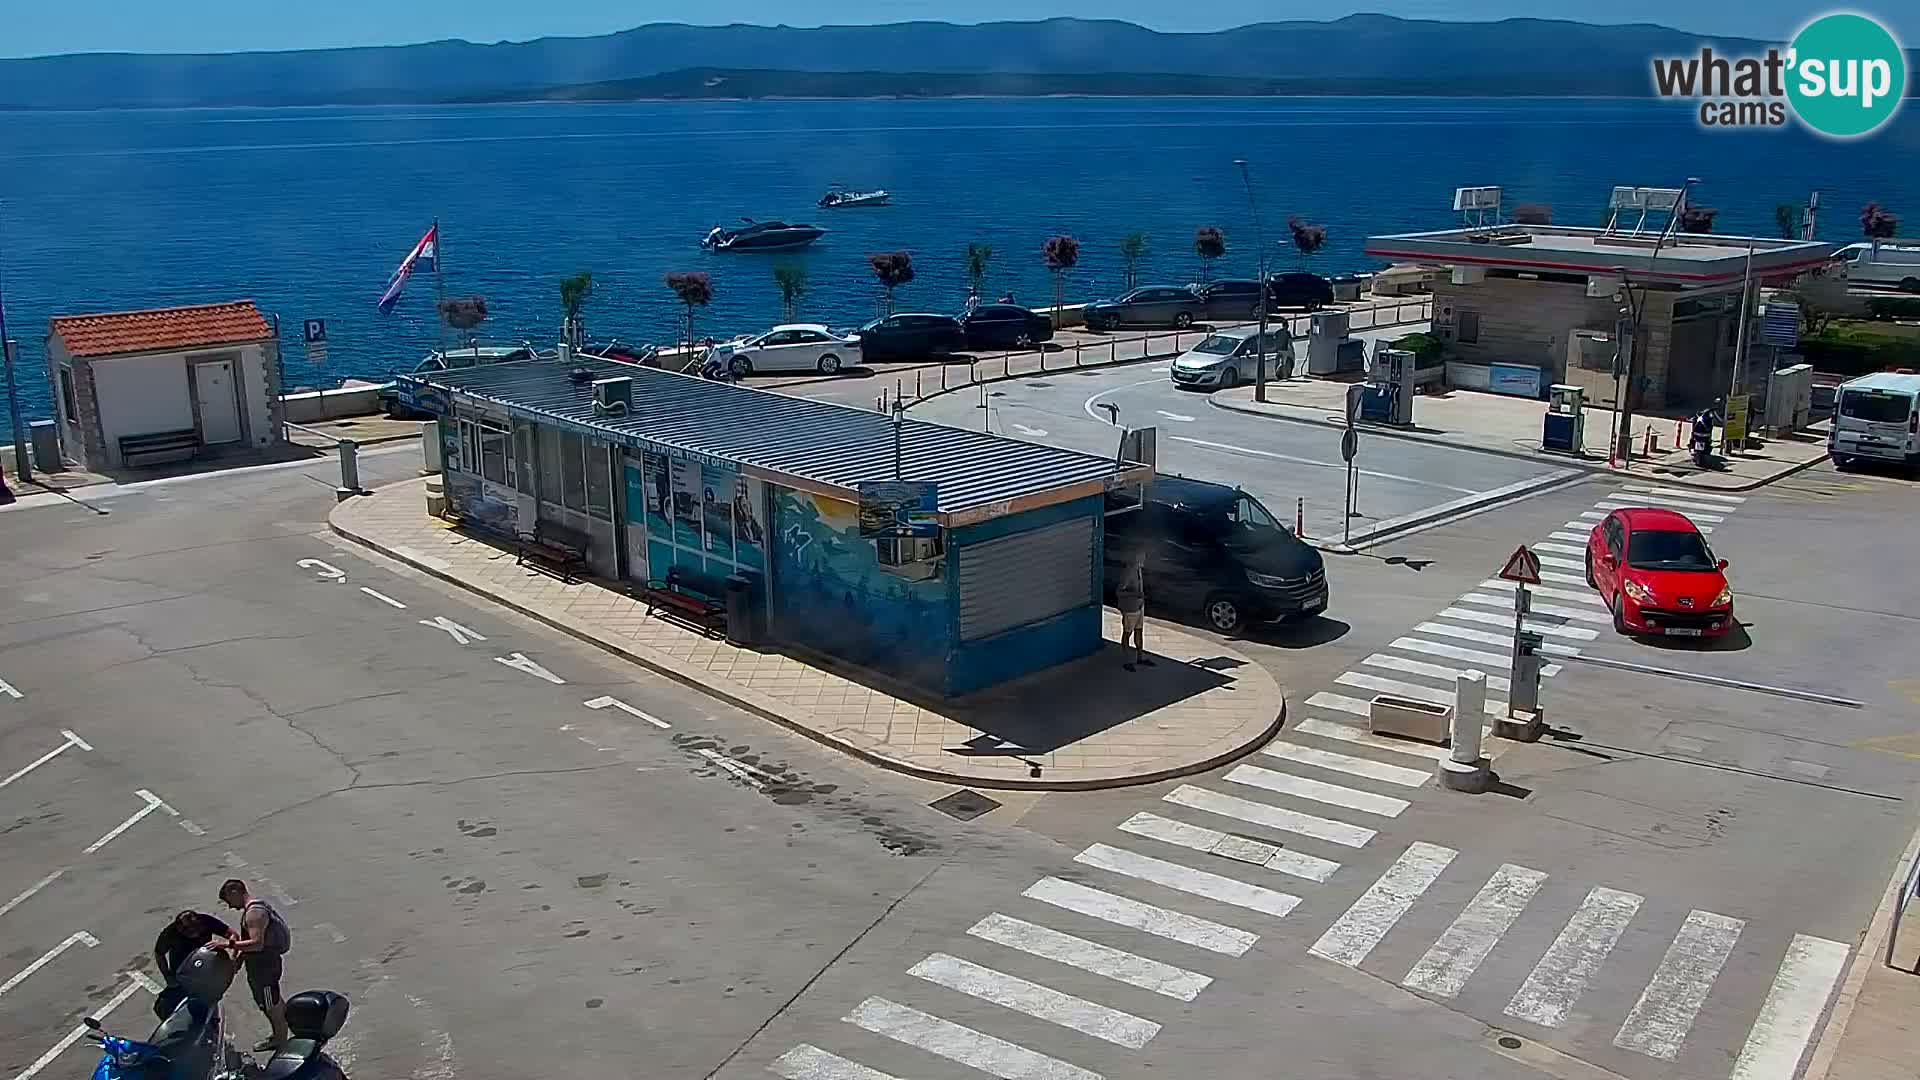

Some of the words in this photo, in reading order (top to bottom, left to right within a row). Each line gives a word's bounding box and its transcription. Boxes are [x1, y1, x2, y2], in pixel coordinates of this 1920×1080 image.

[309, 322, 320, 339] P
[636, 439, 651, 452] BUS
[652, 442, 683, 458] STATION
[685, 450, 709, 465] TICKET
[711, 457, 737, 472] OFFICE
